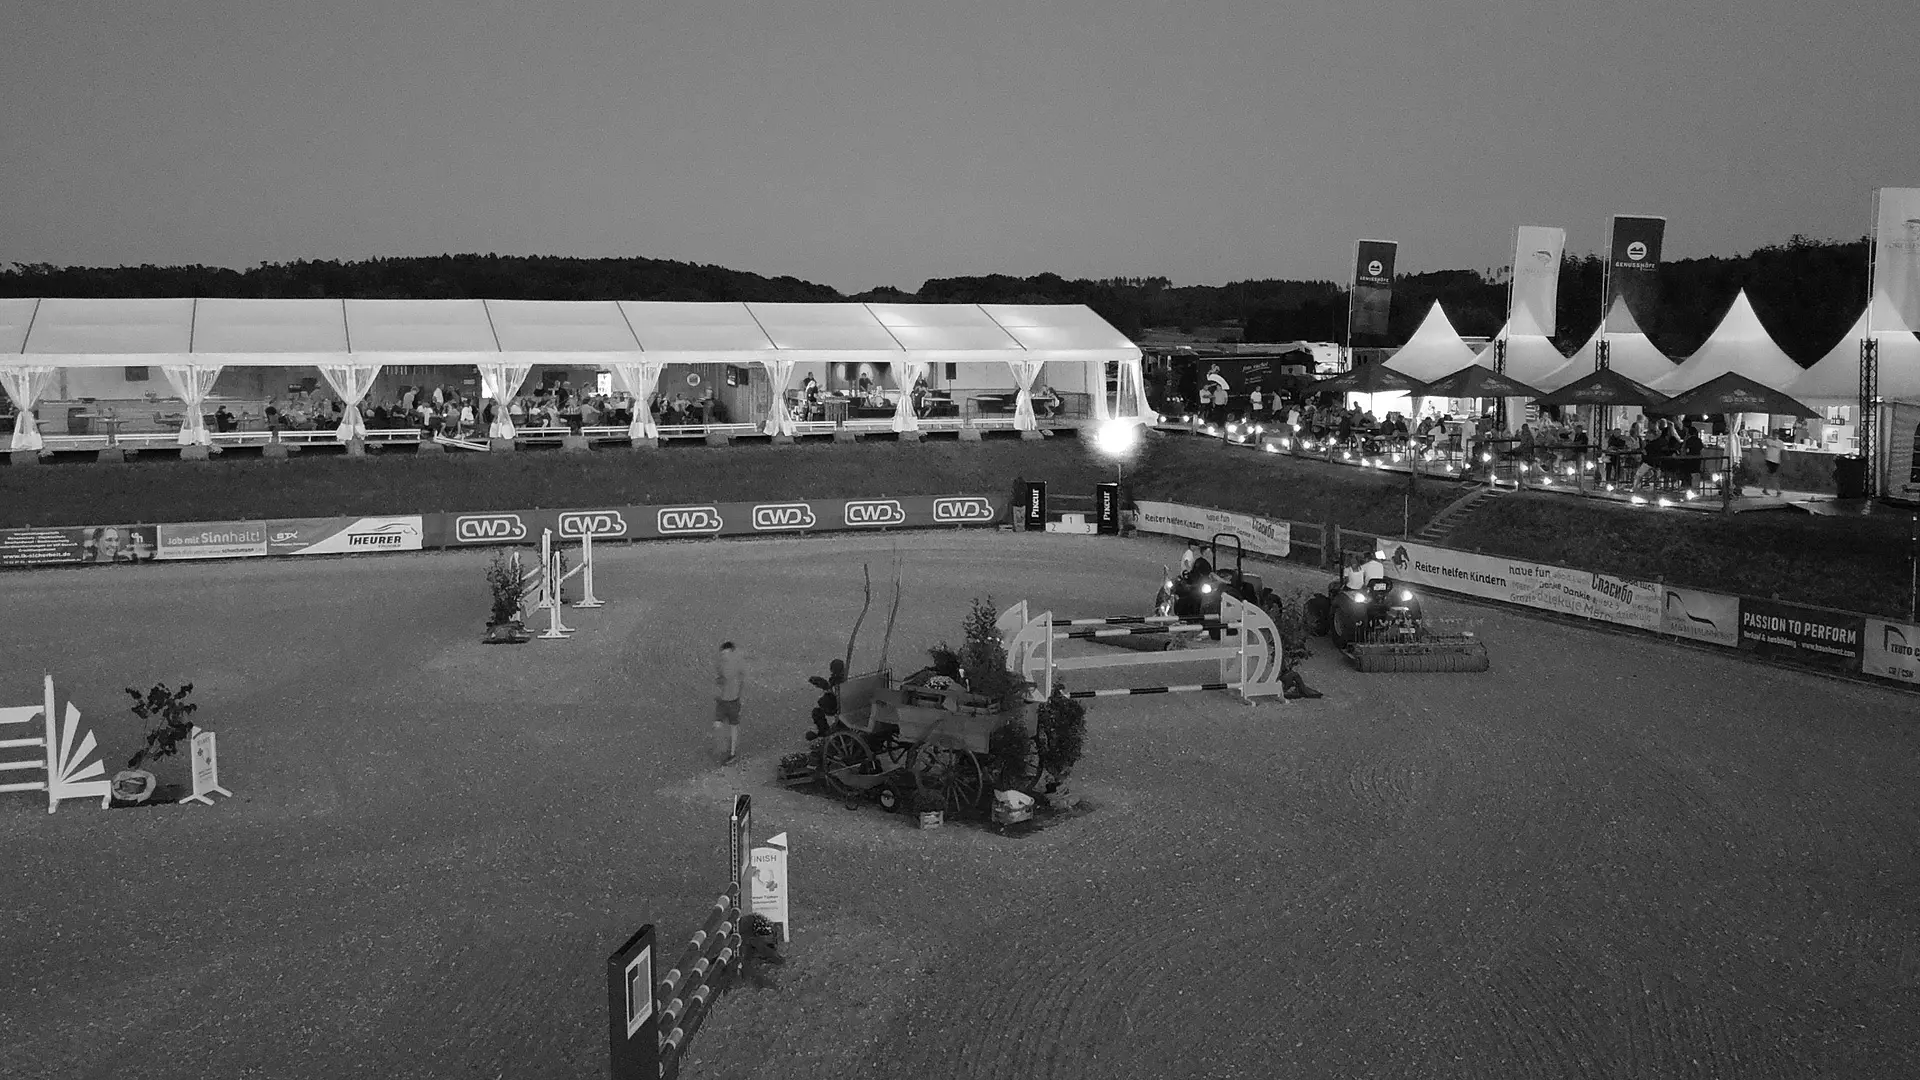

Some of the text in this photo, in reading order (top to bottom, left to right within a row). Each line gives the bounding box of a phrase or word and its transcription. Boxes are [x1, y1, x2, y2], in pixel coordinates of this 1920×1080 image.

[757, 508, 801, 524] CWD
[850, 505, 892, 521] CWD
[938, 502, 980, 518] CWD
[1145, 513, 1166, 523] Reiter
[461, 520, 511, 537] CWD
[564, 515, 611, 532] CWD
[663, 512, 708, 529] CWD
[348, 532, 402, 546] THEURER
[1415, 561, 1441, 575] Reiter
[1442, 564, 1469, 580] helfen
[1470, 572, 1507, 587] Kindern
[1509, 565, 1550, 578] have fun
[1592, 573, 1633, 605] Спасибо
[1744, 612, 1786, 632] PASSION
[1788, 619, 1801, 635] TO
[1803, 622, 1856, 645] PERFORM
[752, 854, 777, 863] INISH
